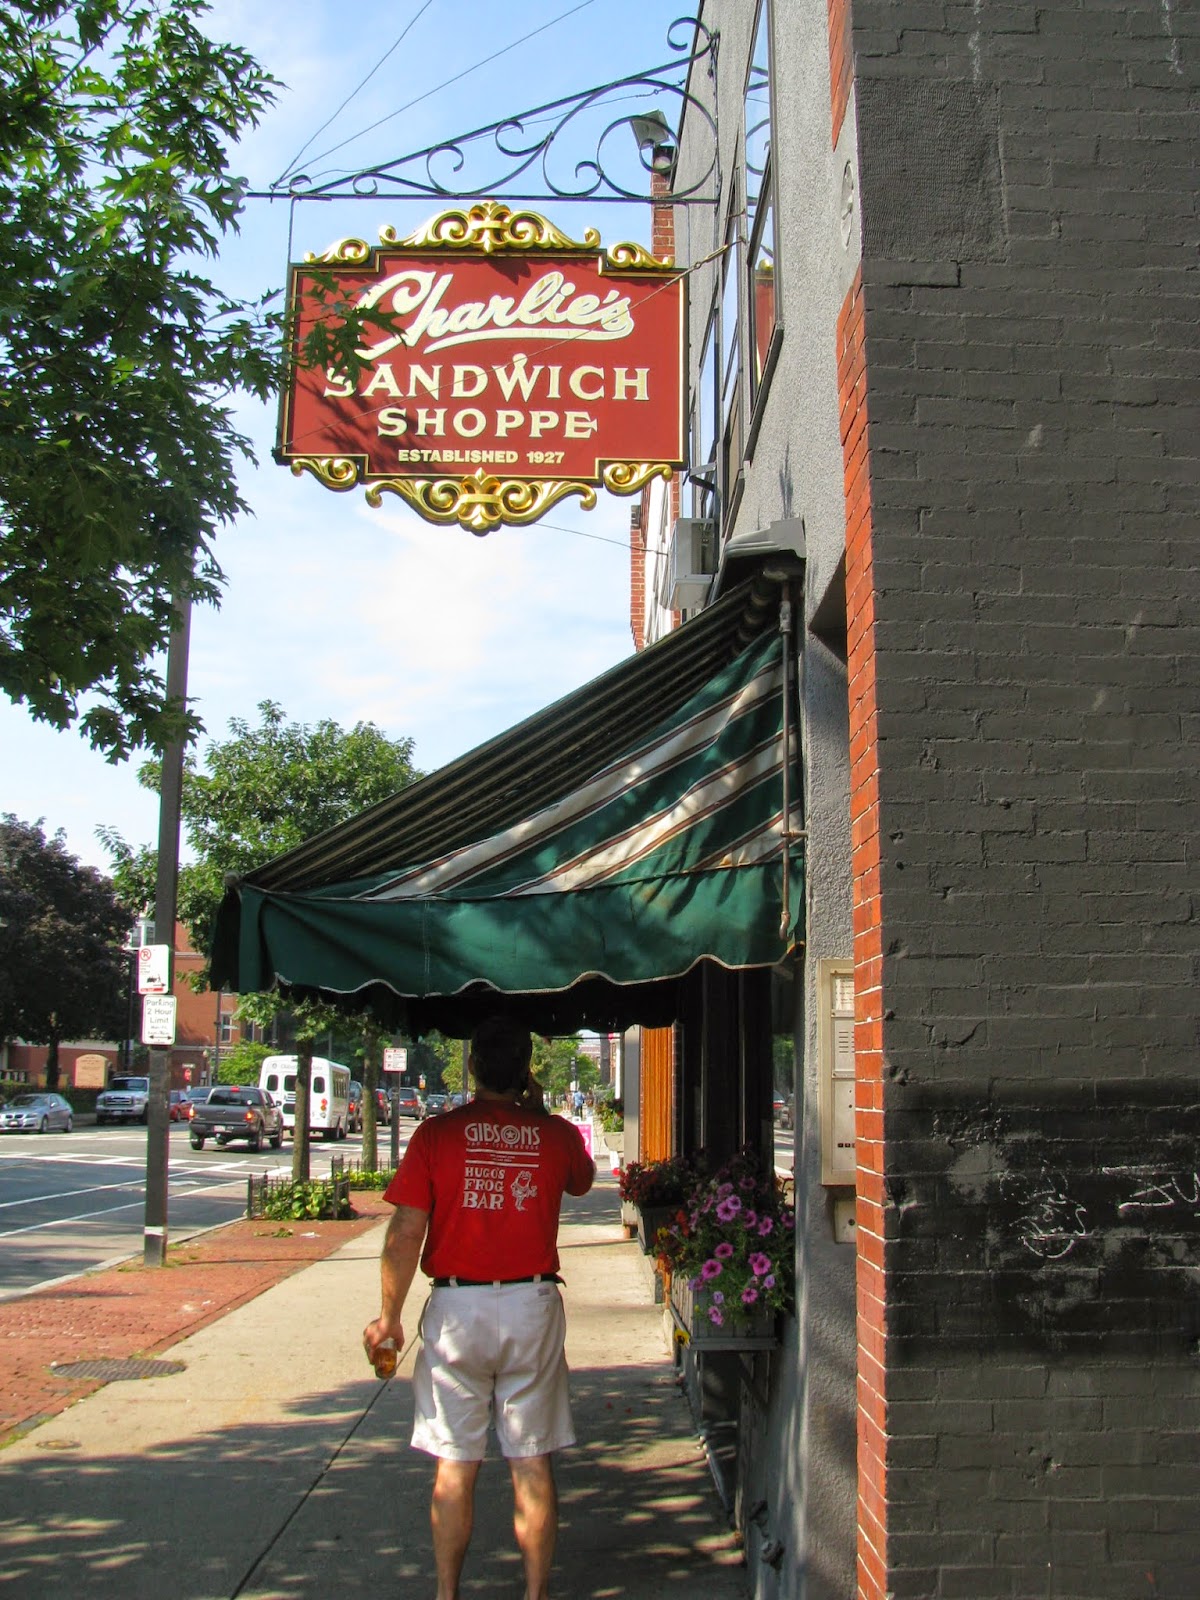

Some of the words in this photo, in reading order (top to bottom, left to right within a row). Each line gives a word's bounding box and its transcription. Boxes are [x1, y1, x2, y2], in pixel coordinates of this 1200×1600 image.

[354, 270, 634, 361] Charlie's
[323, 352, 651, 402] SANDWICH
[377, 407, 598, 439] SHOPPE
[398, 448, 518, 465] ESTABLISHED
[526, 450, 565, 465] 1927
[146, 998, 174, 1008] Parking
[464, 1123, 540, 1145] GIBSONS
[463, 1178, 505, 1193] FROG
[462, 1191, 505, 1210] BAR
